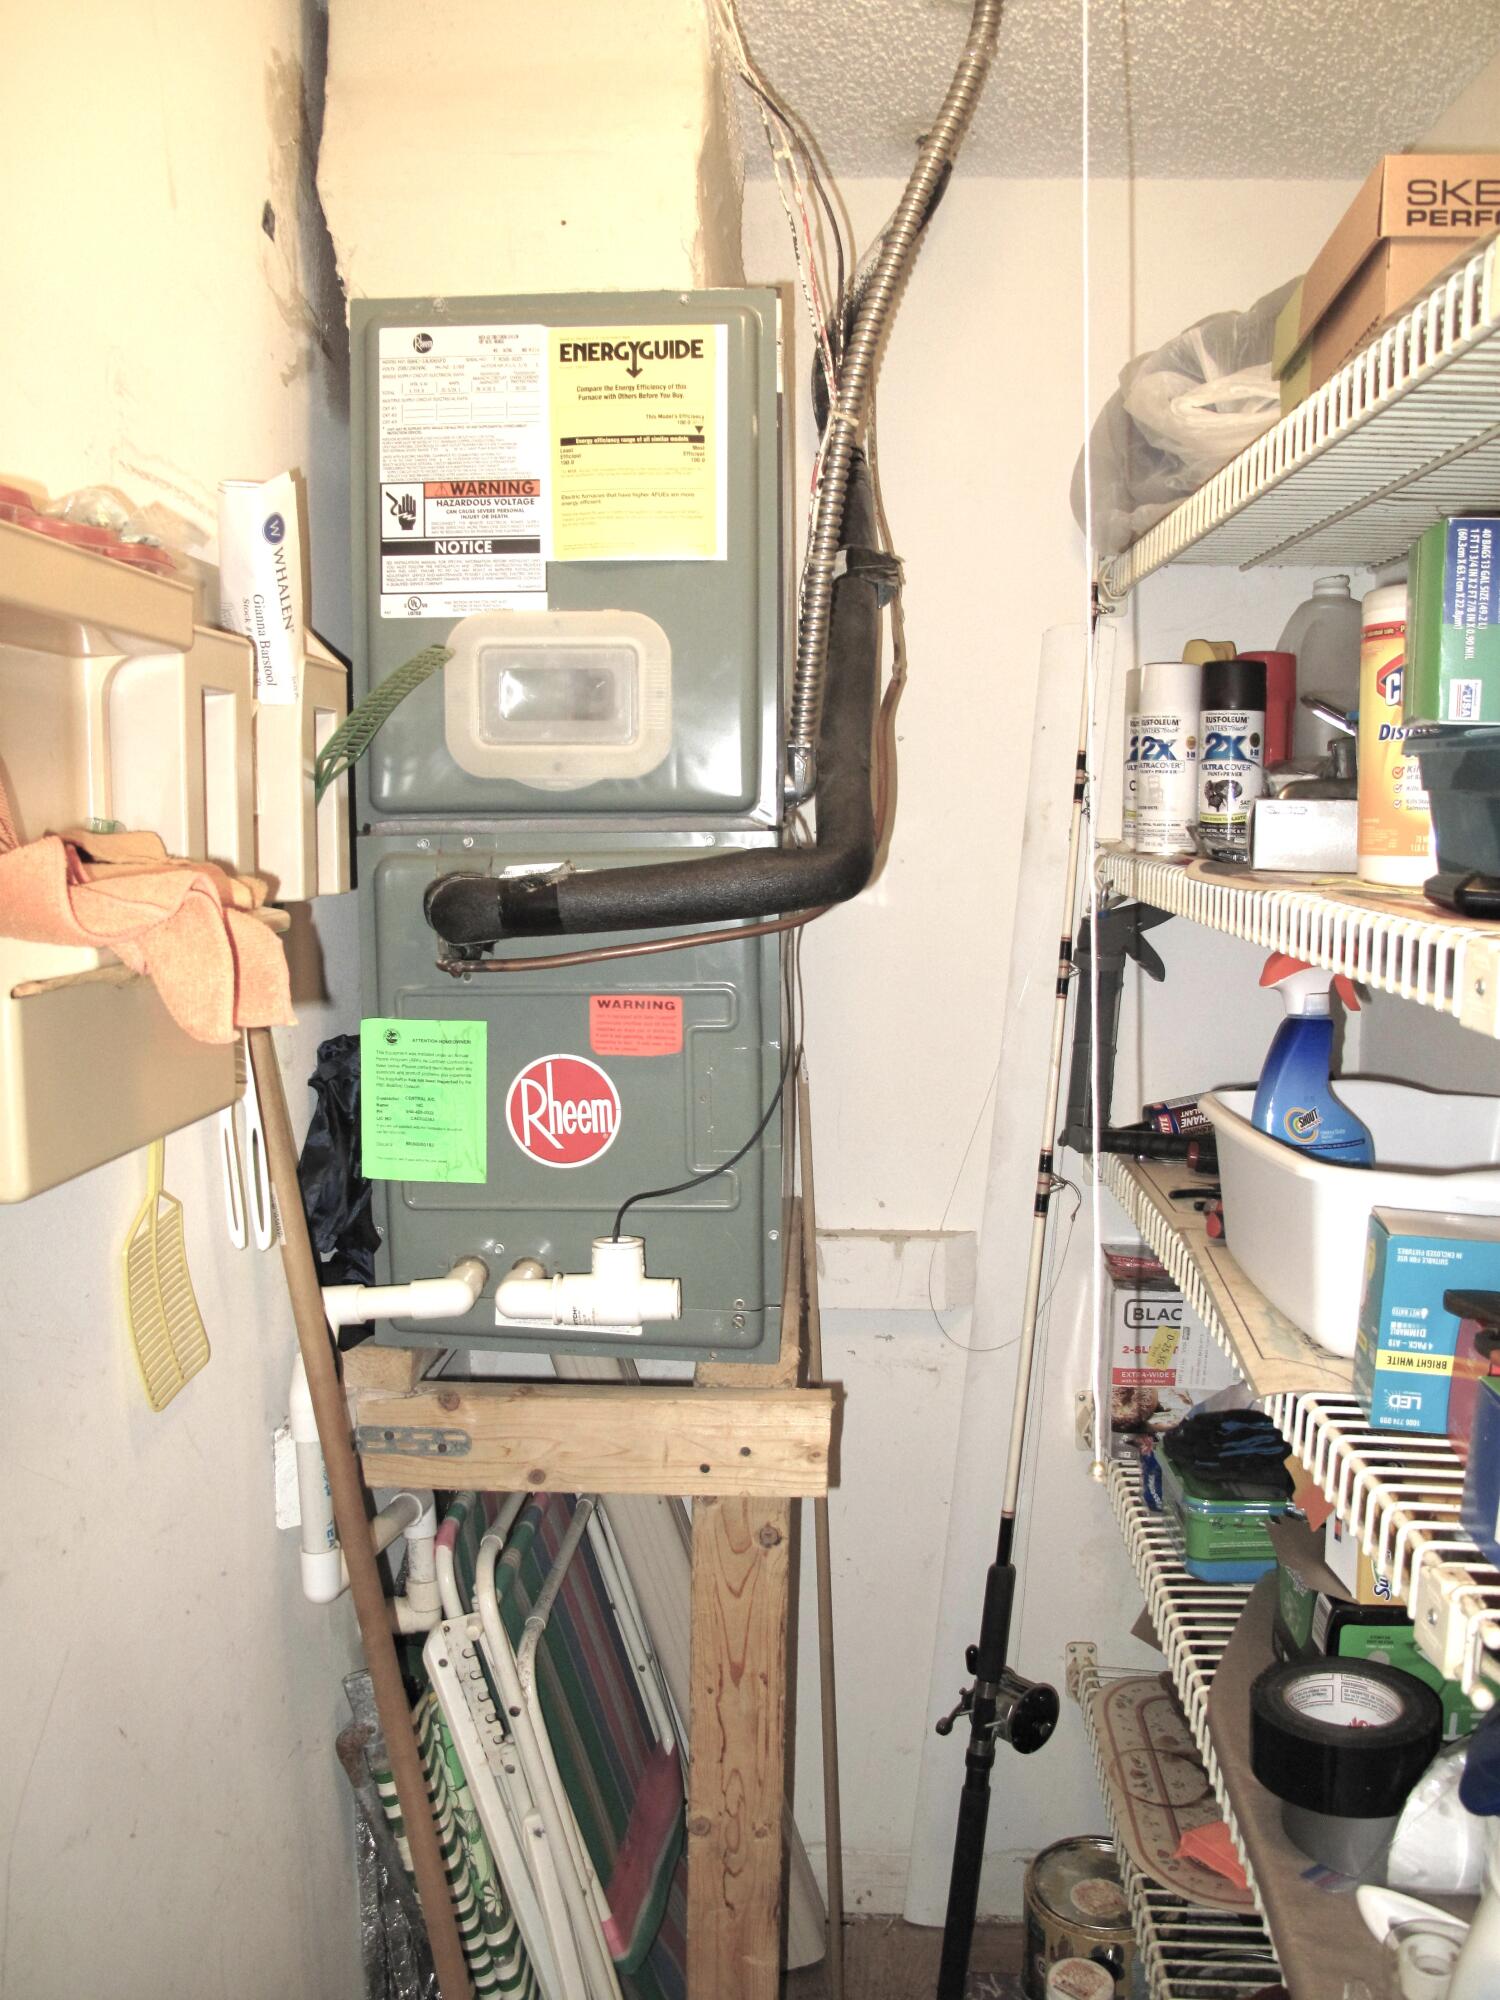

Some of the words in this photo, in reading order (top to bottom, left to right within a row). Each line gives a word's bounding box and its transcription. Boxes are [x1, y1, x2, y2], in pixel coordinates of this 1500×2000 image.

[560, 340, 704, 363] ENERGYGUIDE
[614, 384, 635, 392] Energy
[450, 481, 534, 496] WARNING
[436, 499, 492, 507] HAZARDOUS
[494, 498, 535, 506] VOLTAGE
[1470, 534, 1480, 543] FT
[1482, 528, 1492, 538] 40
[435, 540, 492, 554] NOTICE
[1457, 528, 1468, 558] (60.3cm
[1470, 544, 1479, 553] 11
[1482, 540, 1492, 558] BAGS
[1469, 555, 1479, 568] 3/4
[1480, 560, 1490, 568] 13
[1456, 565, 1466, 592] 63.1cm
[1480, 570, 1490, 584] GAL
[1468, 590, 1478, 599] FT
[1480, 586, 1489, 600] SIZE
[1466, 600, 1477, 612] 7/8
[1478, 602, 1488, 622] (49.2
[1466, 614, 1476, 622] IN
[253, 594, 266, 636] Gianna
[260, 640, 278, 686] Barstool
[1465, 629, 1475, 645] 0.90
[1464, 646, 1474, 660] MIL
[1461, 695, 1472, 716] USA
[1140, 736, 1177, 760] 2X
[1204, 732, 1248, 760] 2X
[597, 1000, 676, 1010] WARNING
[520, 1062, 614, 1150] Rheem
[1298, 1107, 1318, 1128] SHOUT
[1426, 1250, 1455, 1259] ENCLOSED
[1422, 1258, 1448, 1266] SUITABLE
[1408, 1341, 1427, 1350] PACK
[1387, 1356, 1414, 1367] WHITE
[1416, 1359, 1447, 1370] BRIGHT
[1388, 1394, 1422, 1410] LED
